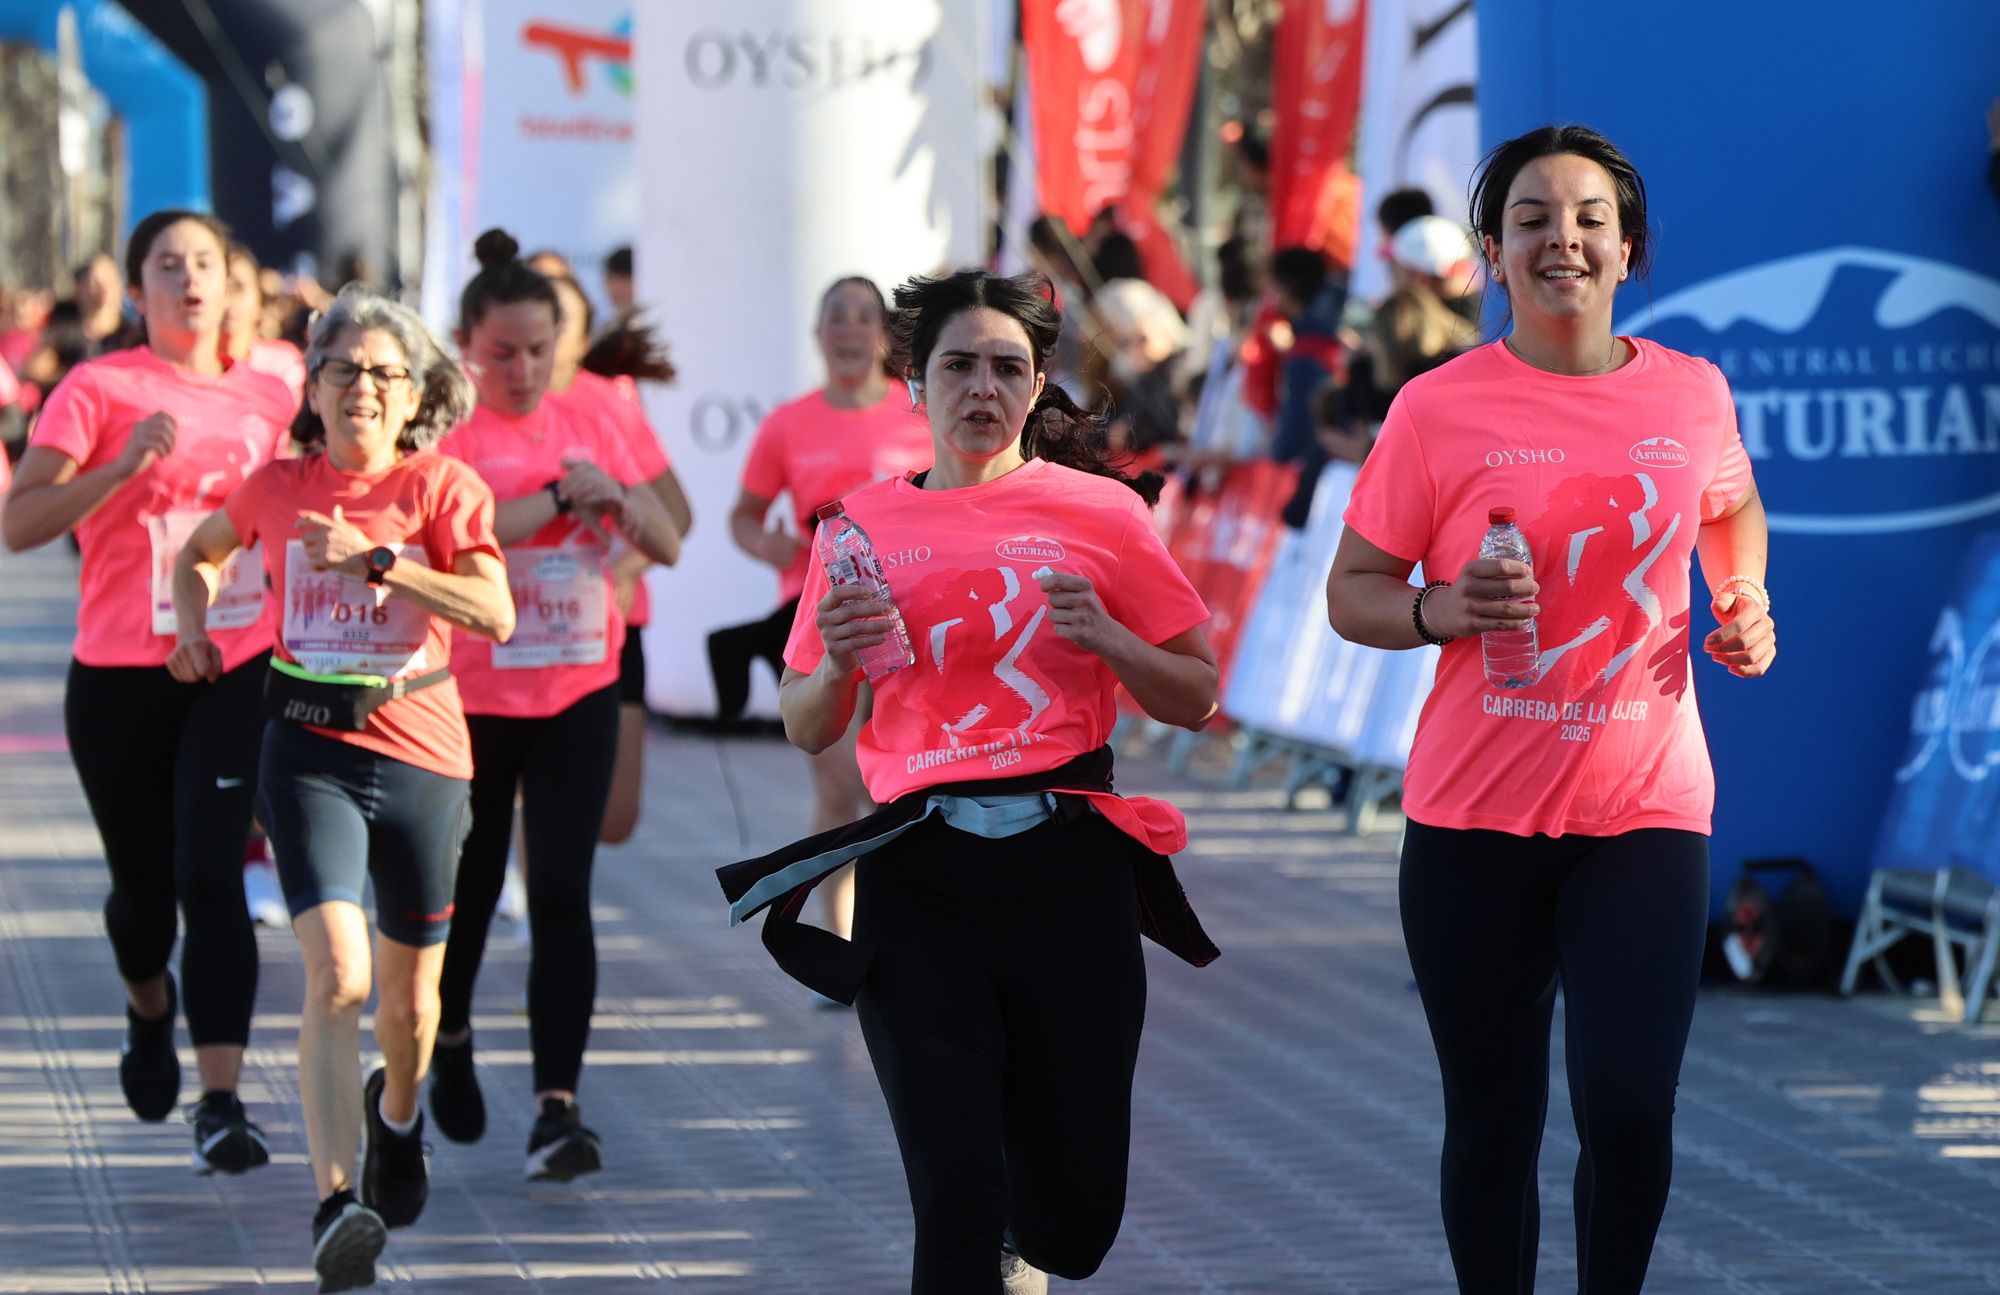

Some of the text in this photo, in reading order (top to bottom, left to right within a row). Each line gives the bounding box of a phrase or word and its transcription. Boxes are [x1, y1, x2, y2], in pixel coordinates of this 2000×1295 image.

[1700, 341, 2000, 377] ENTRAL LECH
[1485, 448, 1565, 468] OYSHO
[1635, 448, 1687, 463] ASTURIANA
[1001, 543, 1061, 559] ASTURIANA
[1482, 693, 1557, 722] CARRERA
[1561, 701, 1584, 721] DE
[1587, 702, 1607, 725] LA
[1560, 724, 1591, 742] 2025
[988, 747, 1022, 771] 2025
